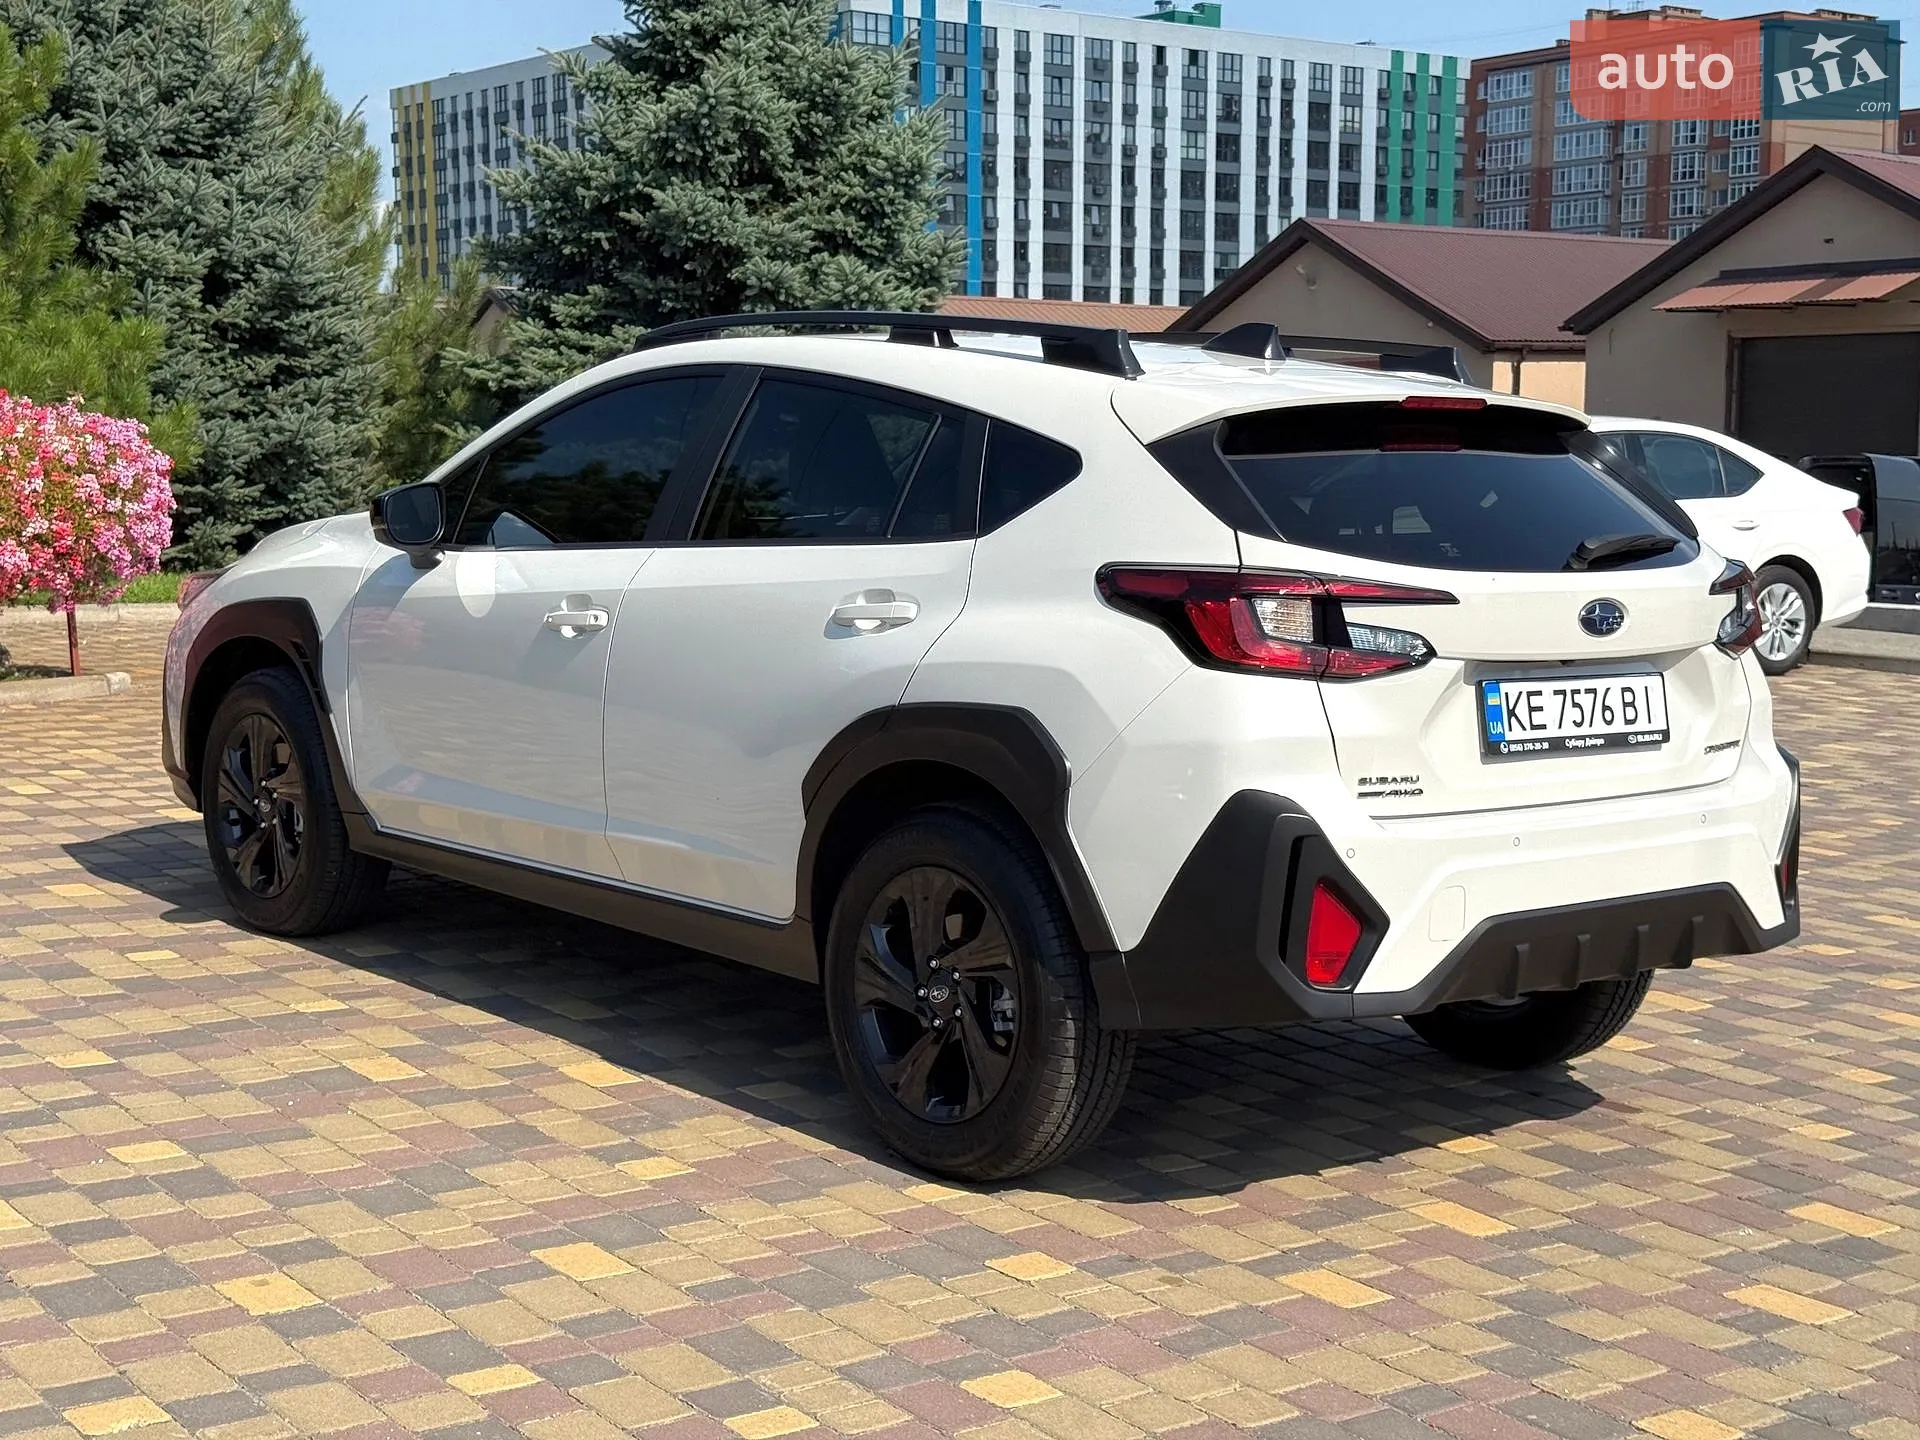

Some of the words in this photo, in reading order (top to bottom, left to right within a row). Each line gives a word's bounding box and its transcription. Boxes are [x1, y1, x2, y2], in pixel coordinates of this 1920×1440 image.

[1505, 690, 1547, 732] KE
[1553, 687, 1615, 729] 7576
[1621, 686, 1652, 725] BI
[1490, 721, 1503, 734] UA
[1358, 774, 1420, 786] SUBARU
